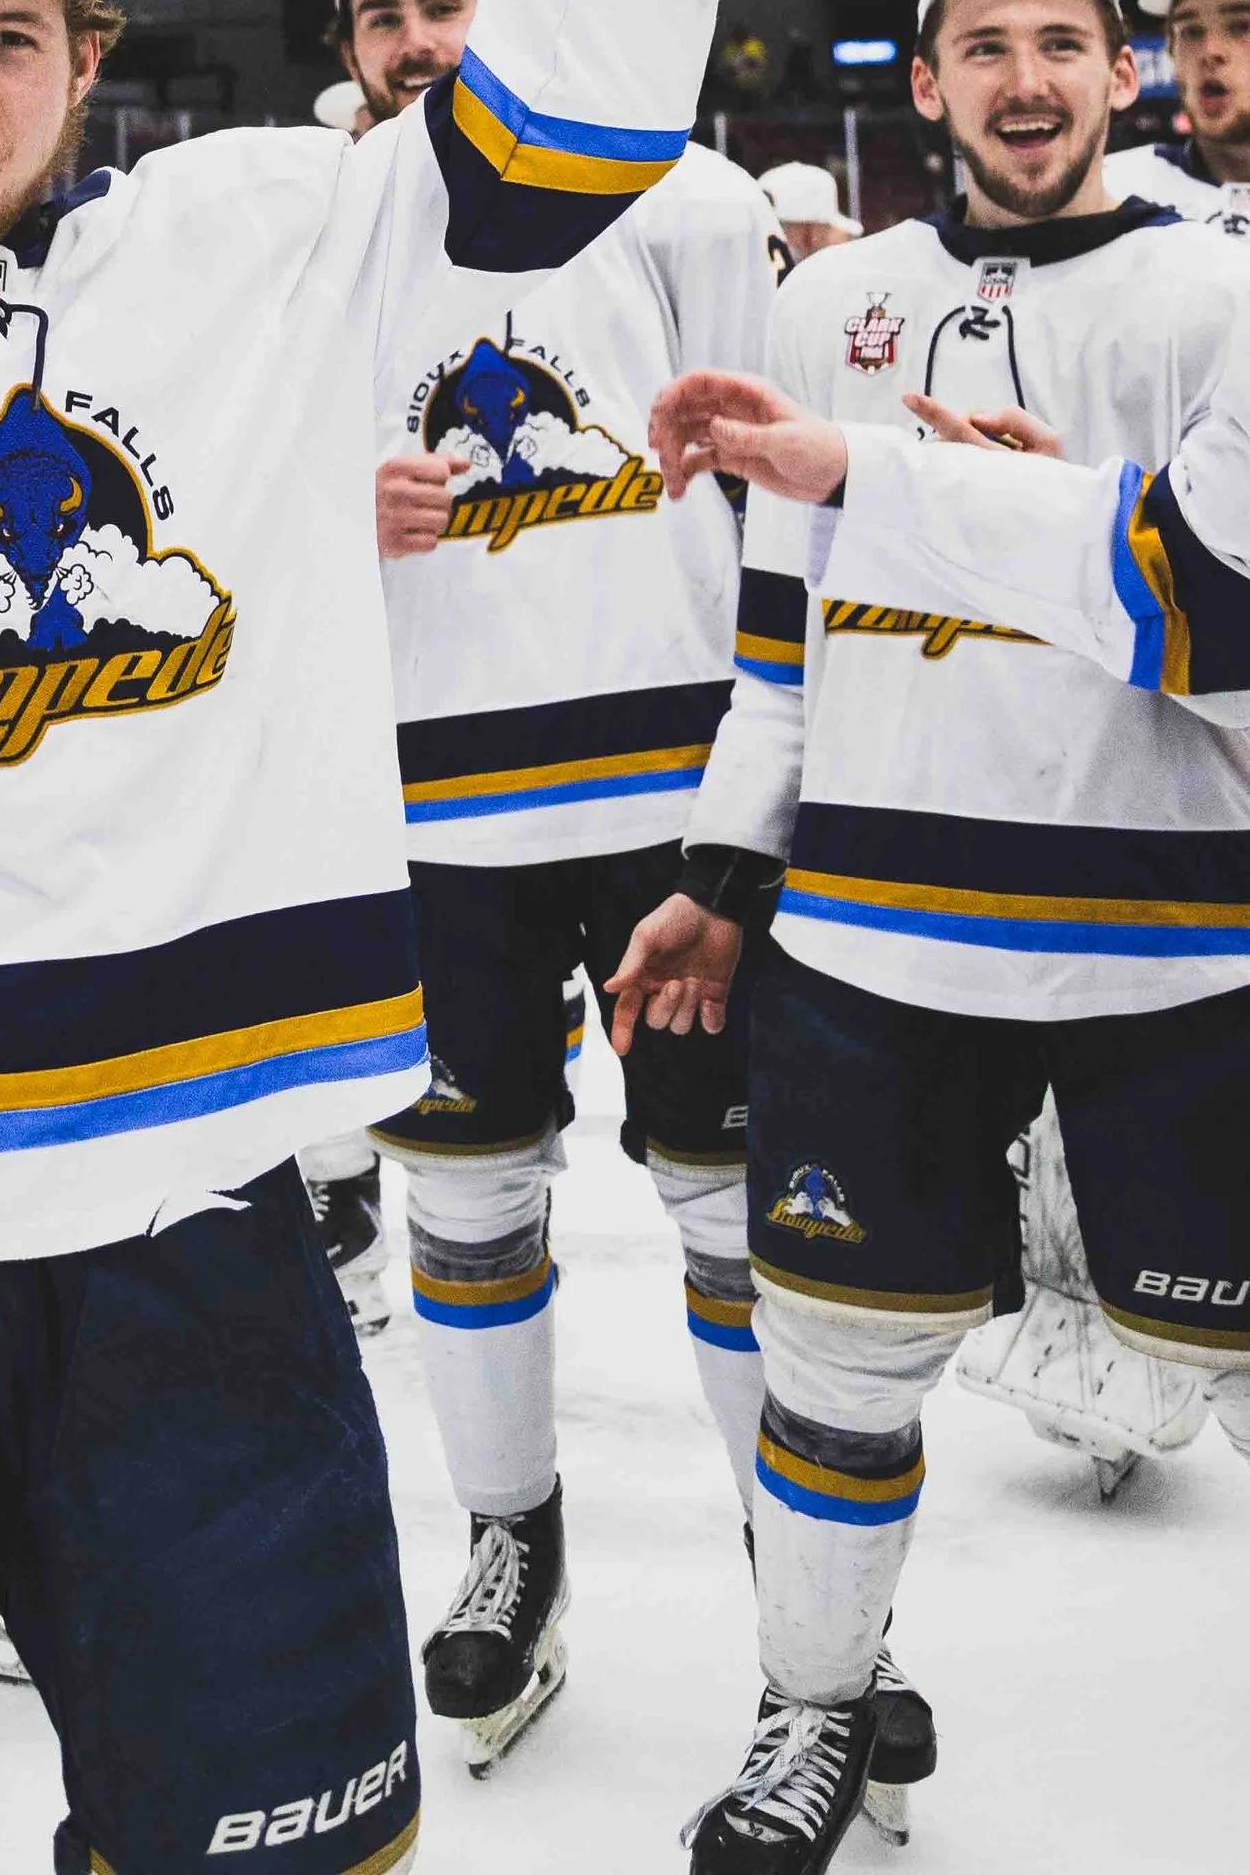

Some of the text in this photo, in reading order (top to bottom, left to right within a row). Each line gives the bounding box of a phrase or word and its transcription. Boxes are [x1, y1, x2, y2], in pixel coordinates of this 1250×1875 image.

[845, 317, 904, 334] CLARK
[855, 332, 891, 347] CUP
[407, 350, 465, 433] SIOUX
[65, 389, 175, 522] FALLS
[438, 455, 664, 555] mpede
[206, 1739, 408, 1856] BAUER
